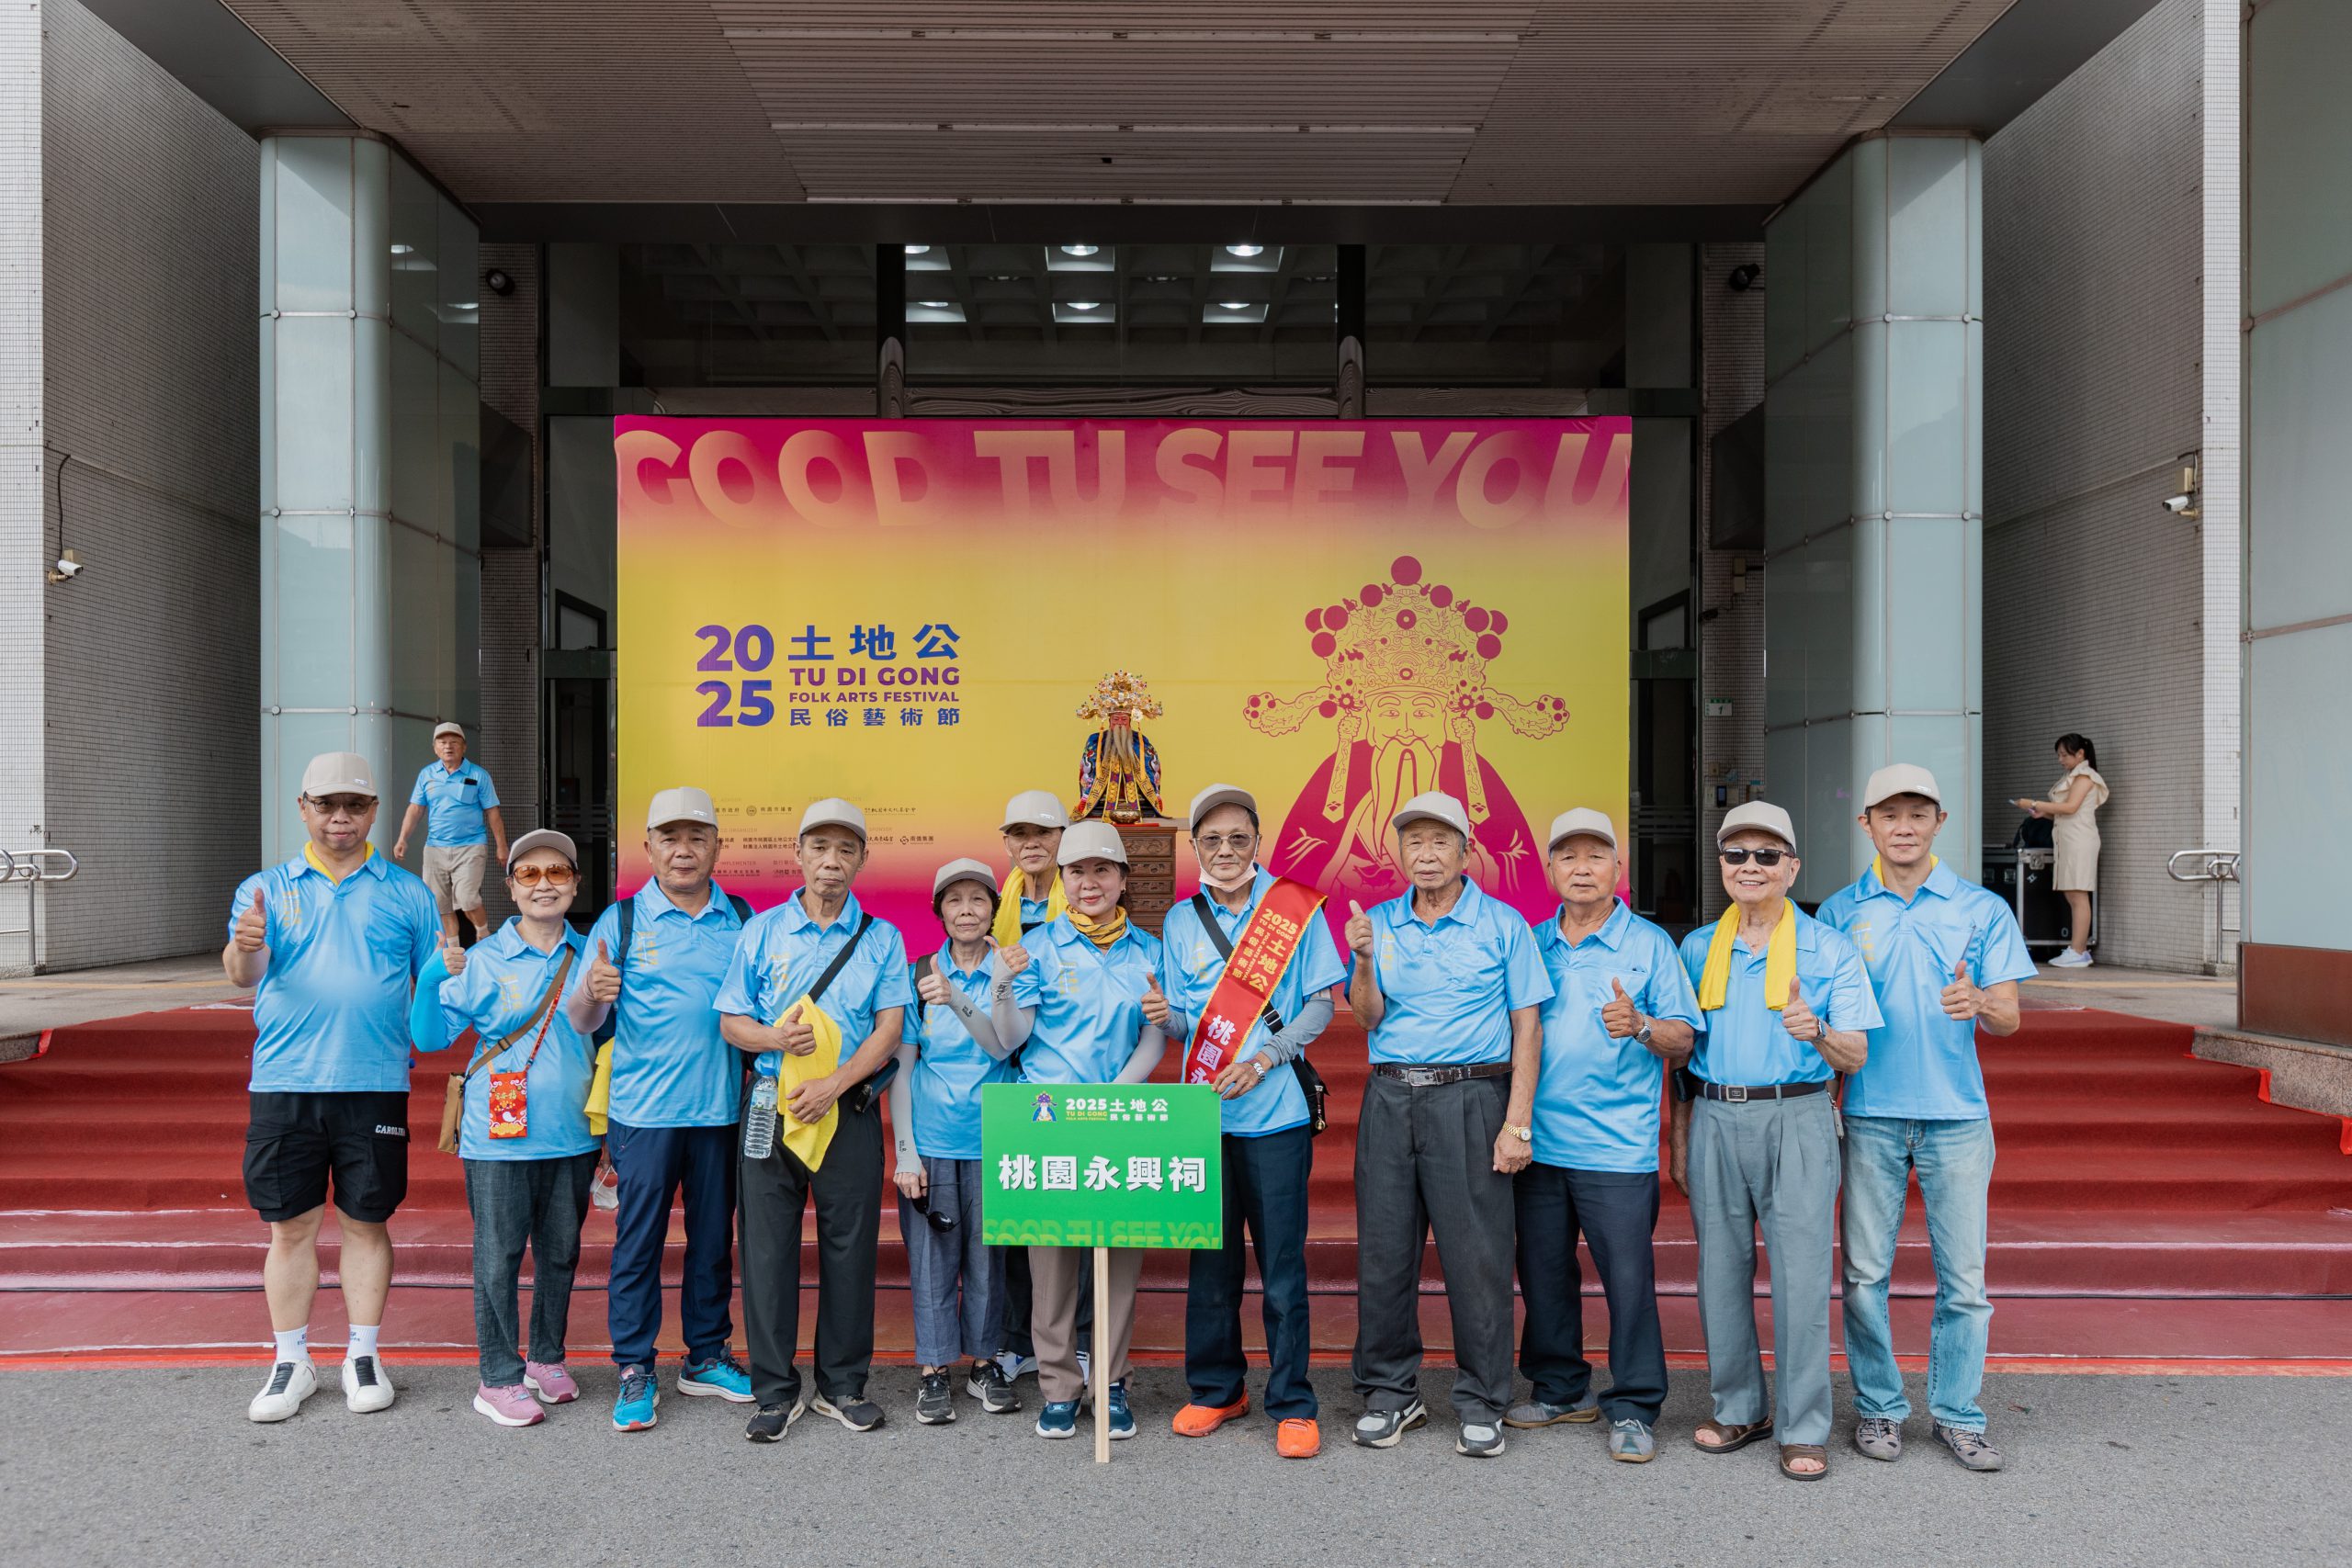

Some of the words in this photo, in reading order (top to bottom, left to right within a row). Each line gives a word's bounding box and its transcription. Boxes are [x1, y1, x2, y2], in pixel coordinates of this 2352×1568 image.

[615, 430, 947, 528] GOOD
[974, 430, 1125, 525] TU
[1155, 428, 1365, 523] SEE
[1391, 430, 1632, 529] YOU
[695, 625, 775, 672] 20
[788, 624, 961, 660] 土地公
[789, 668, 825, 686] TU
[837, 667, 865, 686] DI
[877, 667, 960, 686] GONG
[695, 680, 775, 728] 25
[789, 692, 831, 703] FOLK
[836, 692, 877, 703] ARTS
[884, 691, 960, 703] FESTIVAL
[789, 707, 960, 727] 民俗藝術節
[1261, 908, 1298, 935] 2025
[1268, 923, 1275, 931] DI
[1275, 929, 1294, 942] GONG
[1250, 939, 1286, 992] 土地公
[1066, 1098, 1107, 1111] 2025
[1109, 1098, 1169, 1112] 土地公
[998, 1154, 1206, 1193] 桃園永興祠
